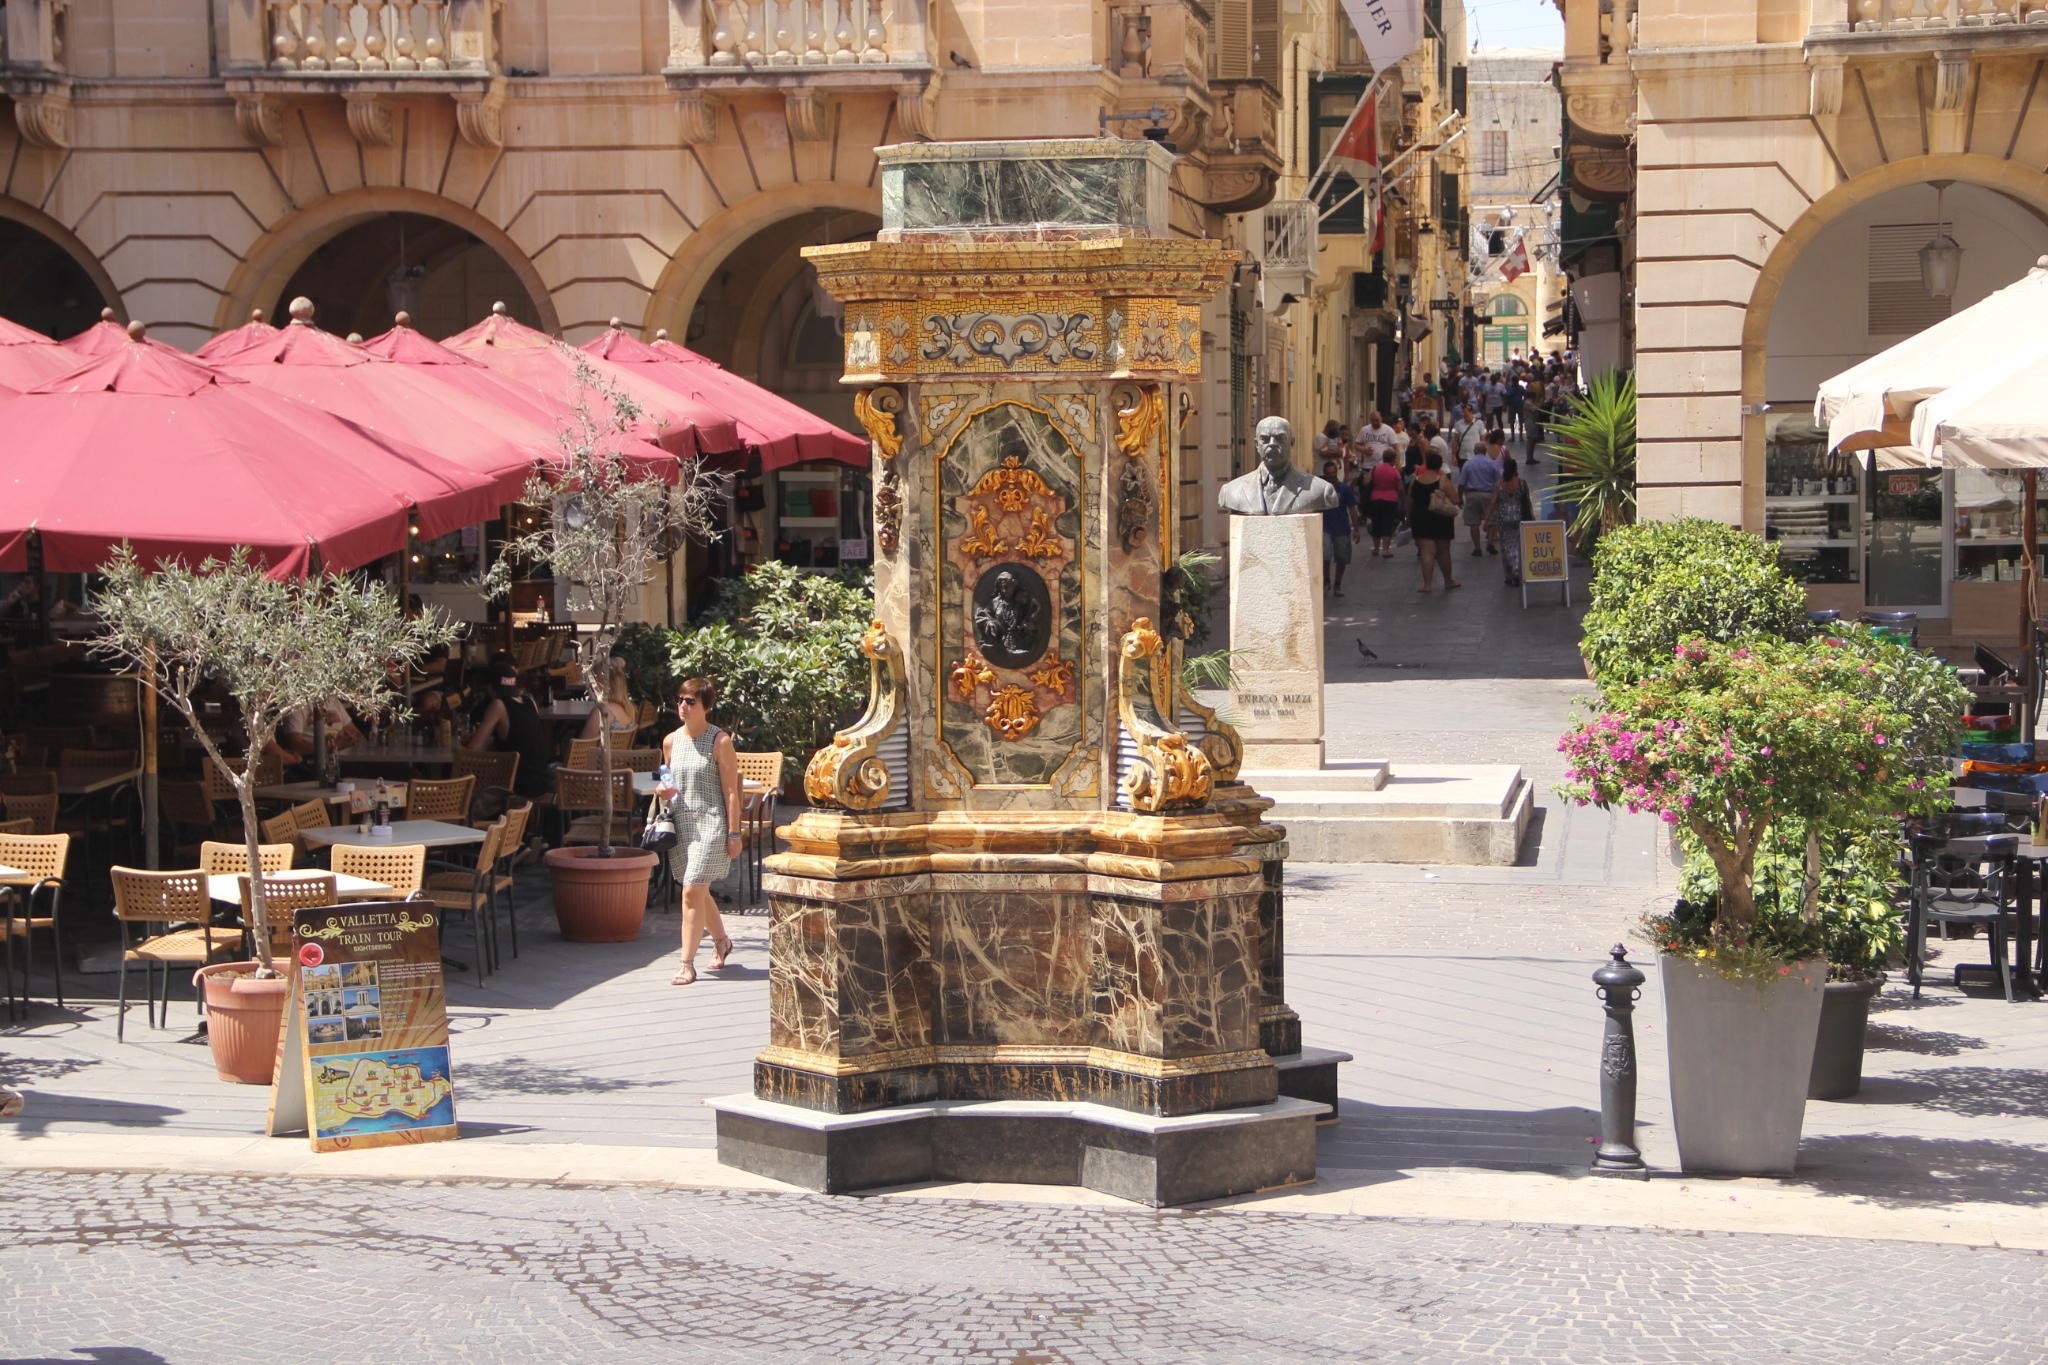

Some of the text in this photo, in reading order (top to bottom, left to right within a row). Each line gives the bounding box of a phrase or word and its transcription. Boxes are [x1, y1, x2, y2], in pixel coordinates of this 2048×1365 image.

[1534, 531, 1552, 544] WE
[840, 548, 865, 557] SALE
[1532, 546, 1555, 558] BUY
[1528, 560, 1561, 573] GOLD
[1237, 694, 1311, 704] ENRICO MIZZI
[1277, 708, 1295, 716] 1950
[340, 913, 397, 927] VALLETTA
[338, 930, 402, 945] TRAIN TOUR
[353, 943, 392, 952] SIGHTSEEING
